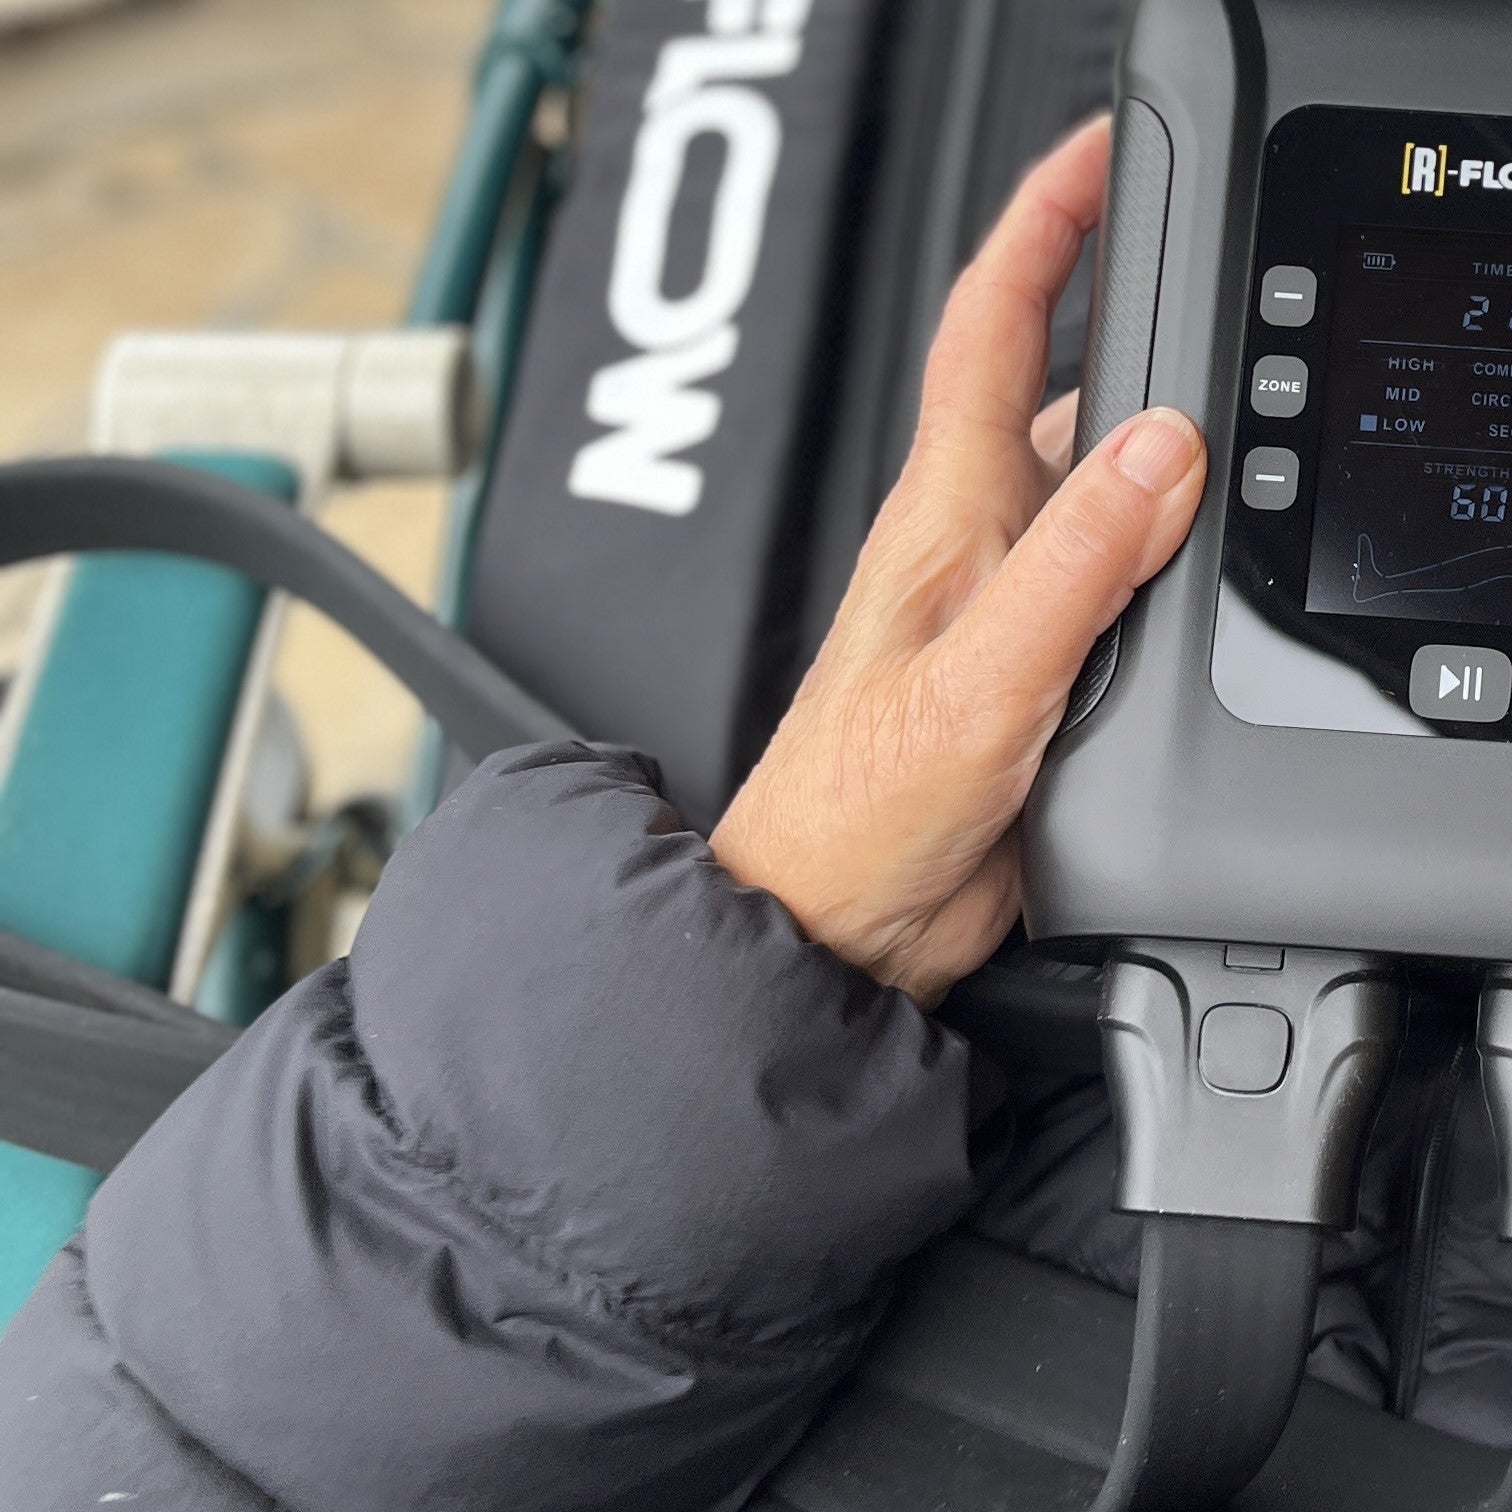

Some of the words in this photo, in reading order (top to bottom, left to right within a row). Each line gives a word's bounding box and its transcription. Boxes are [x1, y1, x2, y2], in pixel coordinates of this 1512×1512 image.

[1387, 356, 1435, 372] HIGH
[1258, 378, 1301, 394] ZONE
[1385, 387, 1421, 402] MID
[1383, 418, 1425, 433] LOW
[1423, 462, 1511, 479] STRENGTH
[1450, 483, 1509, 523] 60
